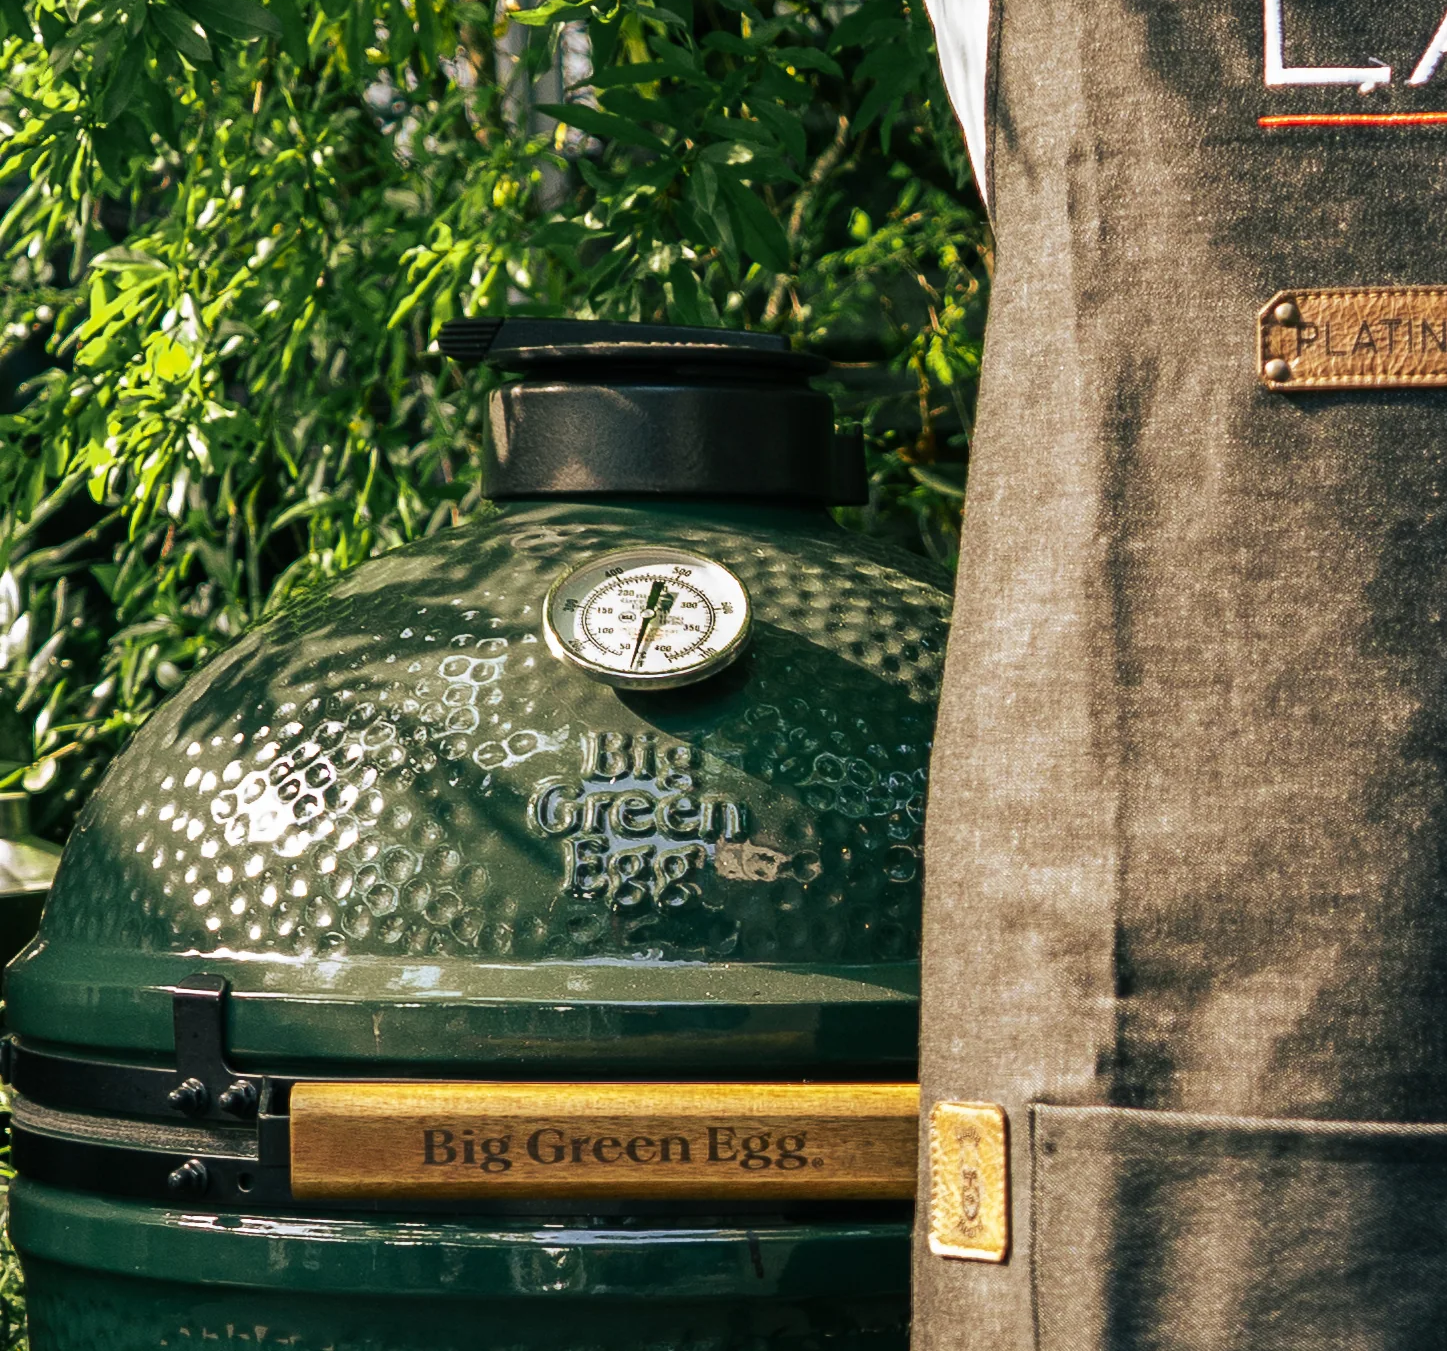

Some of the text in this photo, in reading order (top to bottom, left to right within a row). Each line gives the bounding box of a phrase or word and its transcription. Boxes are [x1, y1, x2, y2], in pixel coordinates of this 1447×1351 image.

[580, 731, 695, 792] Big
[528, 776, 752, 839] Green
[562, 835, 706, 910] Egg
[423, 1129, 513, 1173] Big
[527, 1128, 692, 1164] Green
